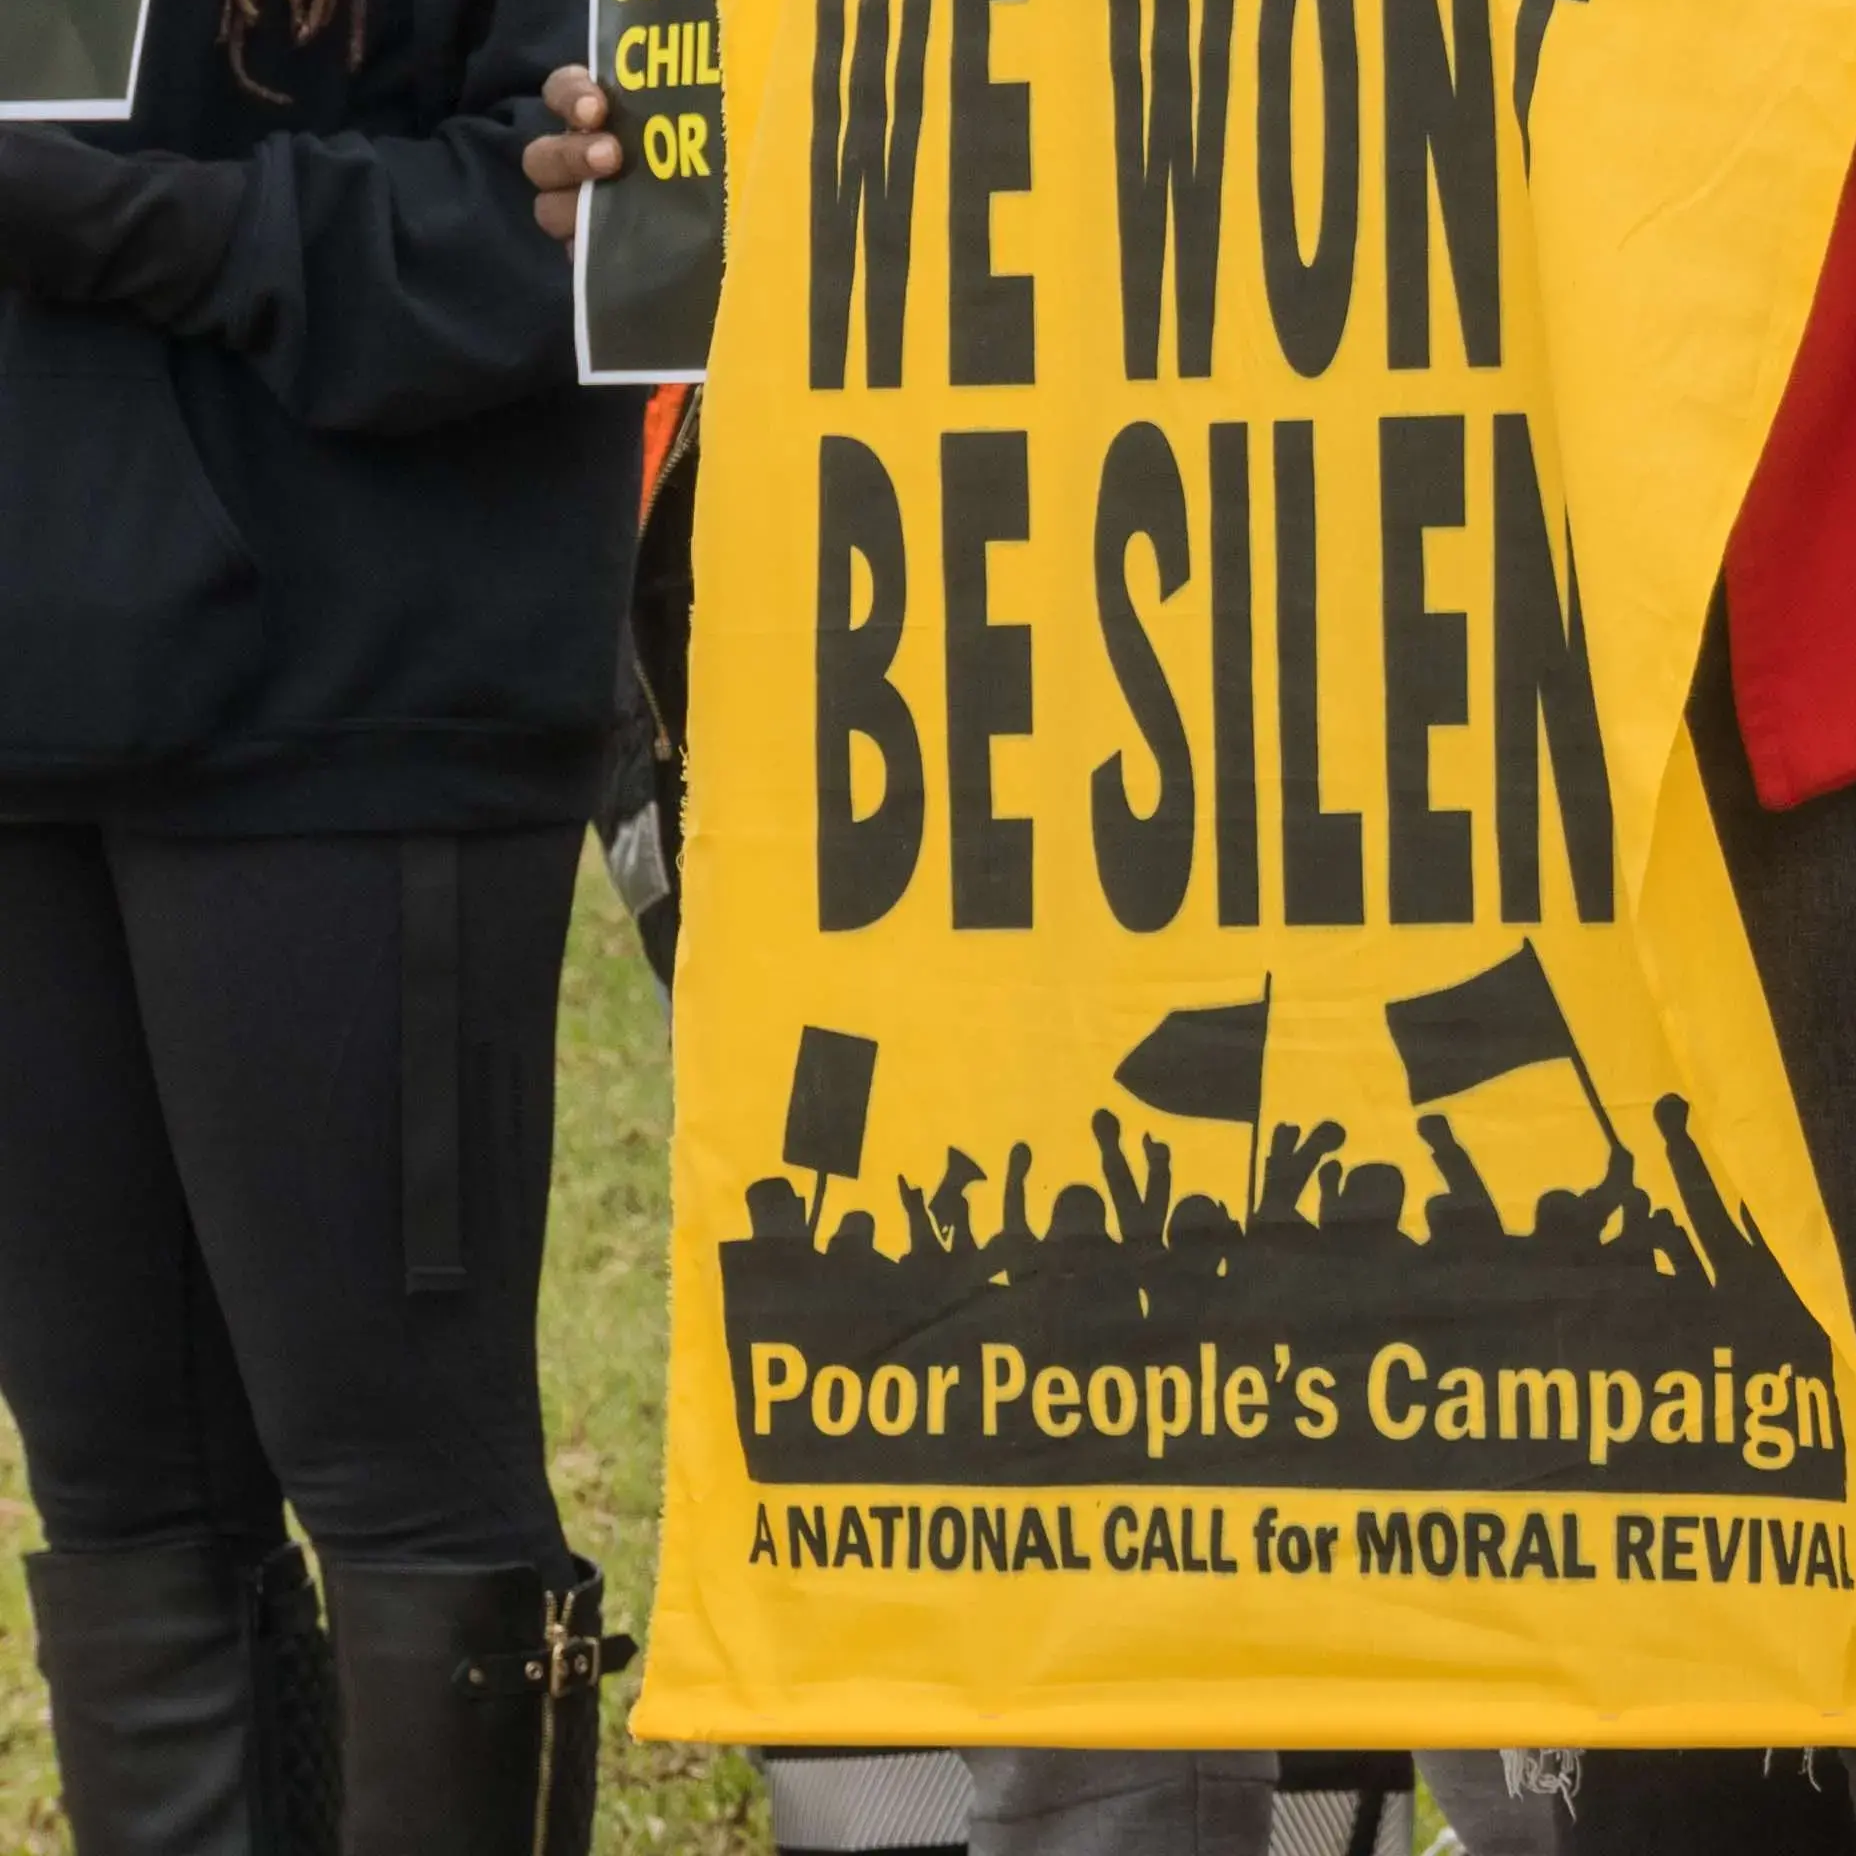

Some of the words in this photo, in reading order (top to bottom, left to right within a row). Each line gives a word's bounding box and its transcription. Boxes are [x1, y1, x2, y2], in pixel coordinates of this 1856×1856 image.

[643, 113, 711, 180] OR
[816, 429, 1034, 934] BE
[750, 1342, 960, 1437] Poor
[981, 1342, 1340, 1458] People's
[1366, 1342, 1835, 1472] Campaign
[749, 1502, 778, 1567] A
[787, 1503, 1091, 1572] NATIONAL
[1103, 1504, 1238, 1574] CALL
[1252, 1507, 1340, 1576] for
[1355, 1511, 1597, 1581] MORAL
[1614, 1515, 1855, 1591] REVIVAL
